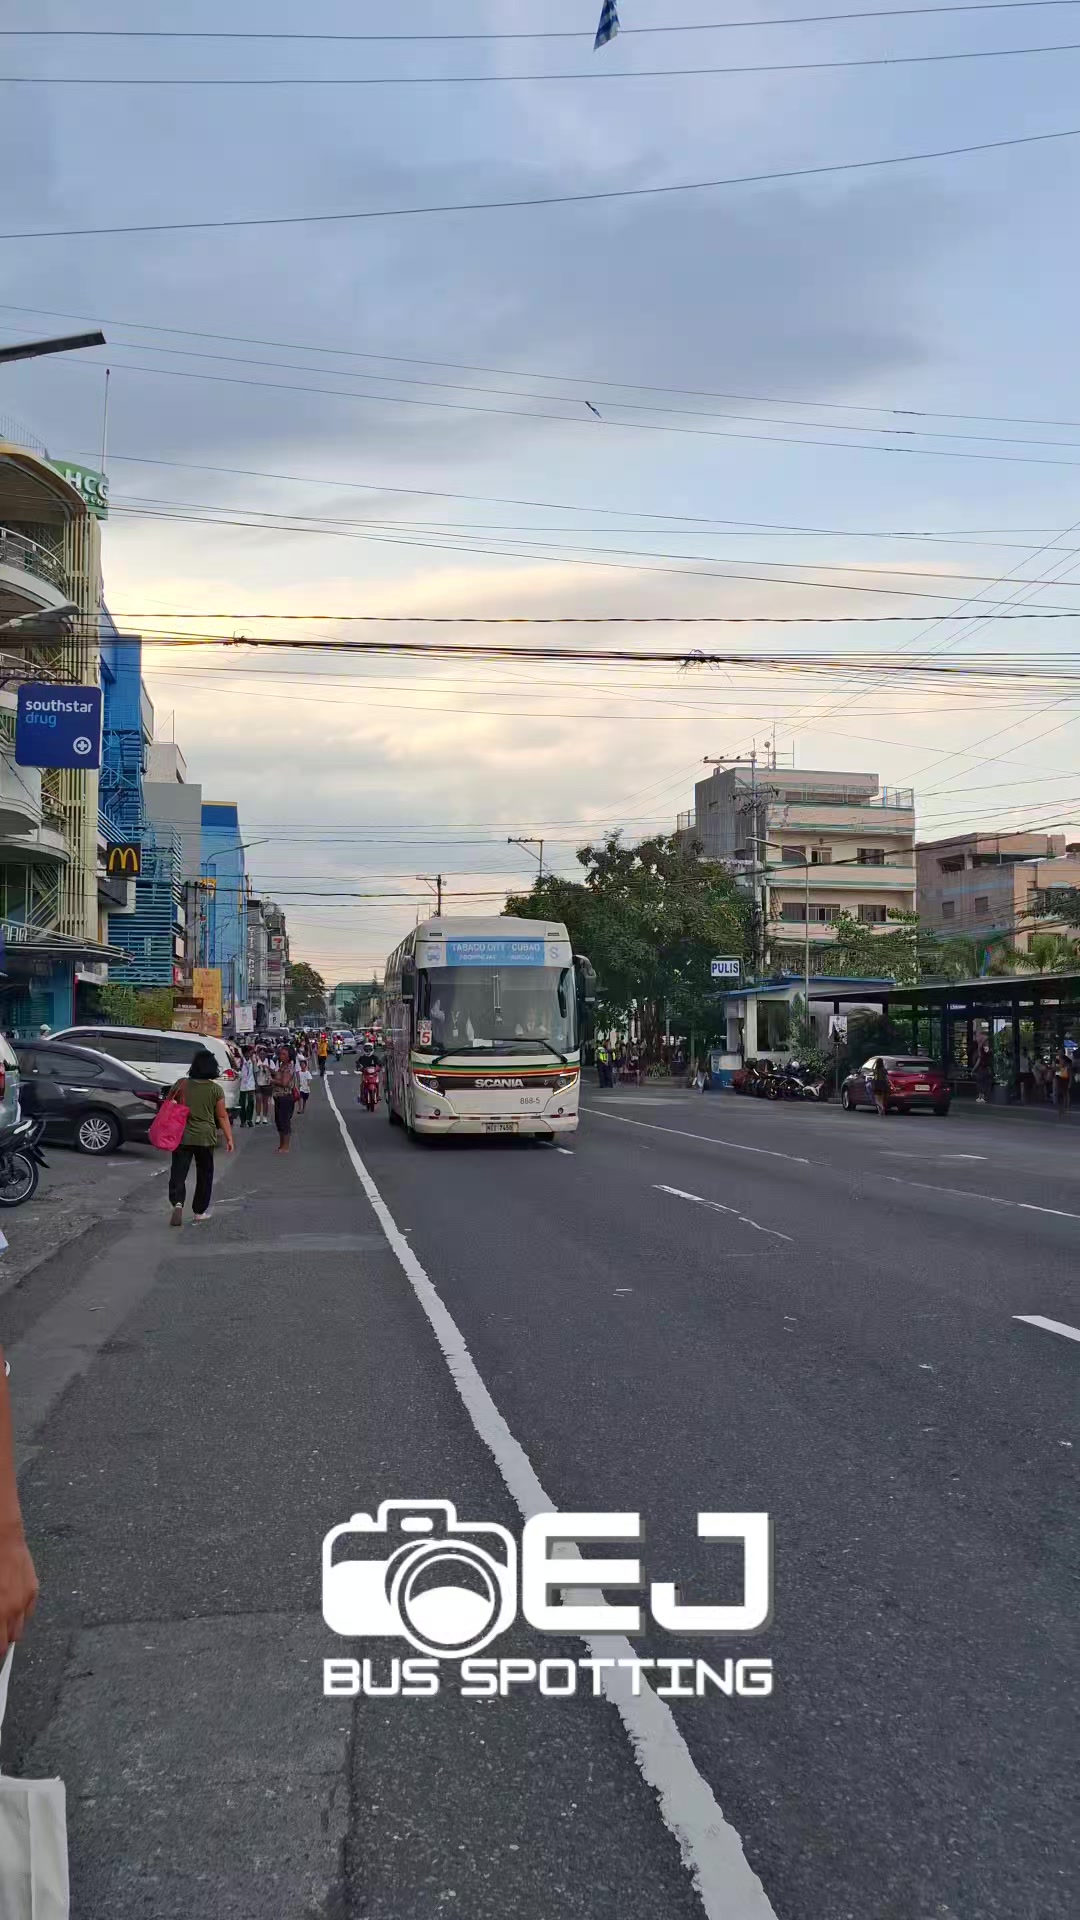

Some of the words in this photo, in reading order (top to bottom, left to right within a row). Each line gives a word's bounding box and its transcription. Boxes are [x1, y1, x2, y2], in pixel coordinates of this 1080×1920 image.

[25, 699, 93, 713] southstar
[25, 712, 57, 728] drug
[452, 943, 486, 952] TABACO
[511, 943, 541, 952] CUBAO
[711, 962, 739, 974] PULIS
[421, 1031, 431, 1044] 5
[474, 1078, 524, 1088] SCANIA
